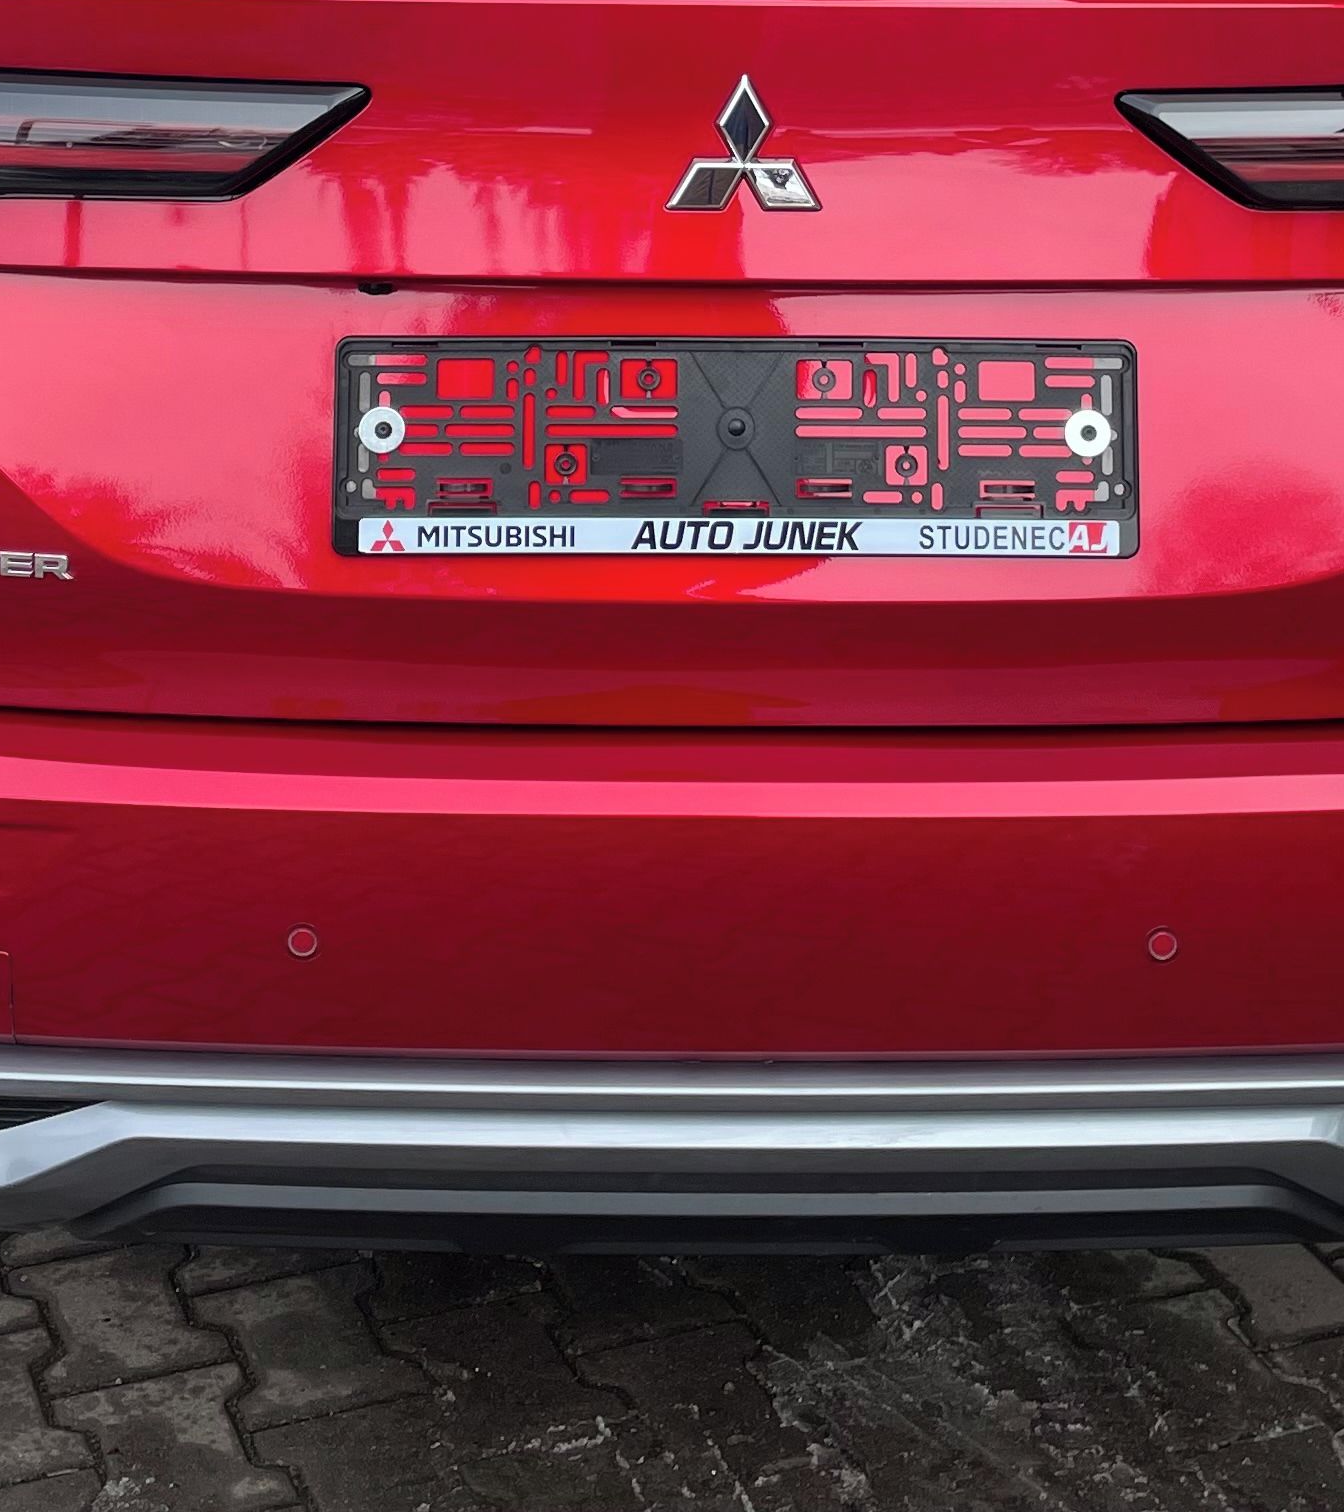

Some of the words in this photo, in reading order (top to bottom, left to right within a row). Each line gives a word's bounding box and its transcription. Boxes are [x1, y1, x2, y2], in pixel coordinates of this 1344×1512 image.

[417, 524, 576, 548] MITSUBISHI
[631, 520, 734, 550] AUTO
[742, 520, 864, 551] JUNEK
[918, 524, 1066, 551] STUDENEC
